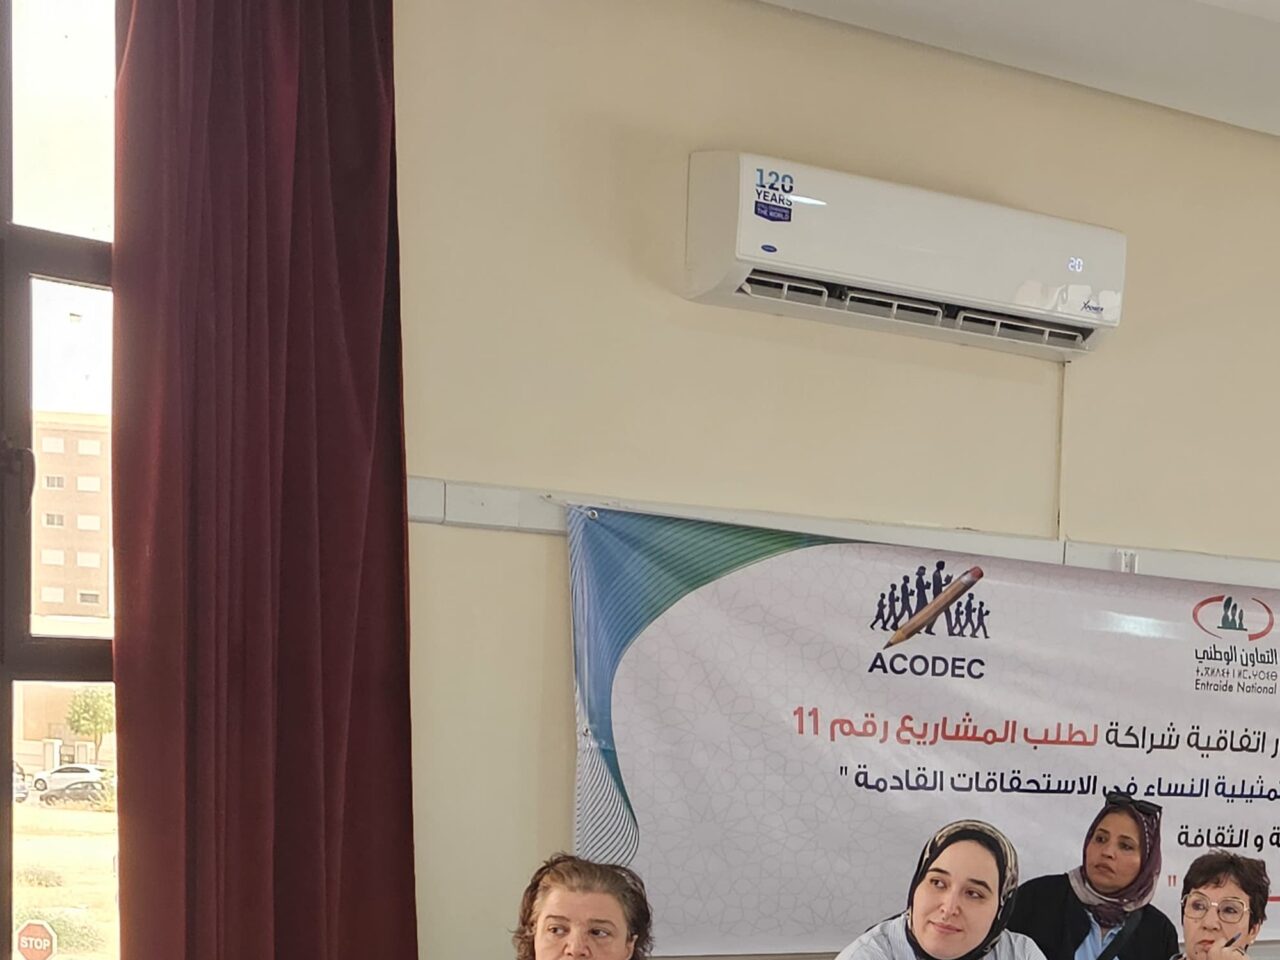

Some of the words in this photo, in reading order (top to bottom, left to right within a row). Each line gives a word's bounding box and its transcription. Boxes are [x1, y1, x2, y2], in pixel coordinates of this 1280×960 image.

[755, 168, 794, 194] 120
[755, 188, 793, 207] YEARS
[868, 652, 986, 680] ACODEC
[1194, 643, 1237, 664] الوطني
[1239, 647, 1278, 667] التعاون
[1194, 678, 1234, 693] Entraide
[1236, 681, 1277, 695] National
[793, 706, 819, 737] 11
[829, 712, 889, 744] رقم
[895, 712, 1017, 747] المشاريع
[1023, 722, 1098, 750] لطلب
[1105, 722, 1180, 754] شراكة
[1187, 725, 1266, 758] اتفاقية
[854, 765, 944, 793] القادمة
[950, 769, 1098, 796] الاستحقاقات
[1144, 776, 1210, 799] النساء
[1177, 824, 1249, 849] الثقافة
[20, 936, 51, 951] STOP
